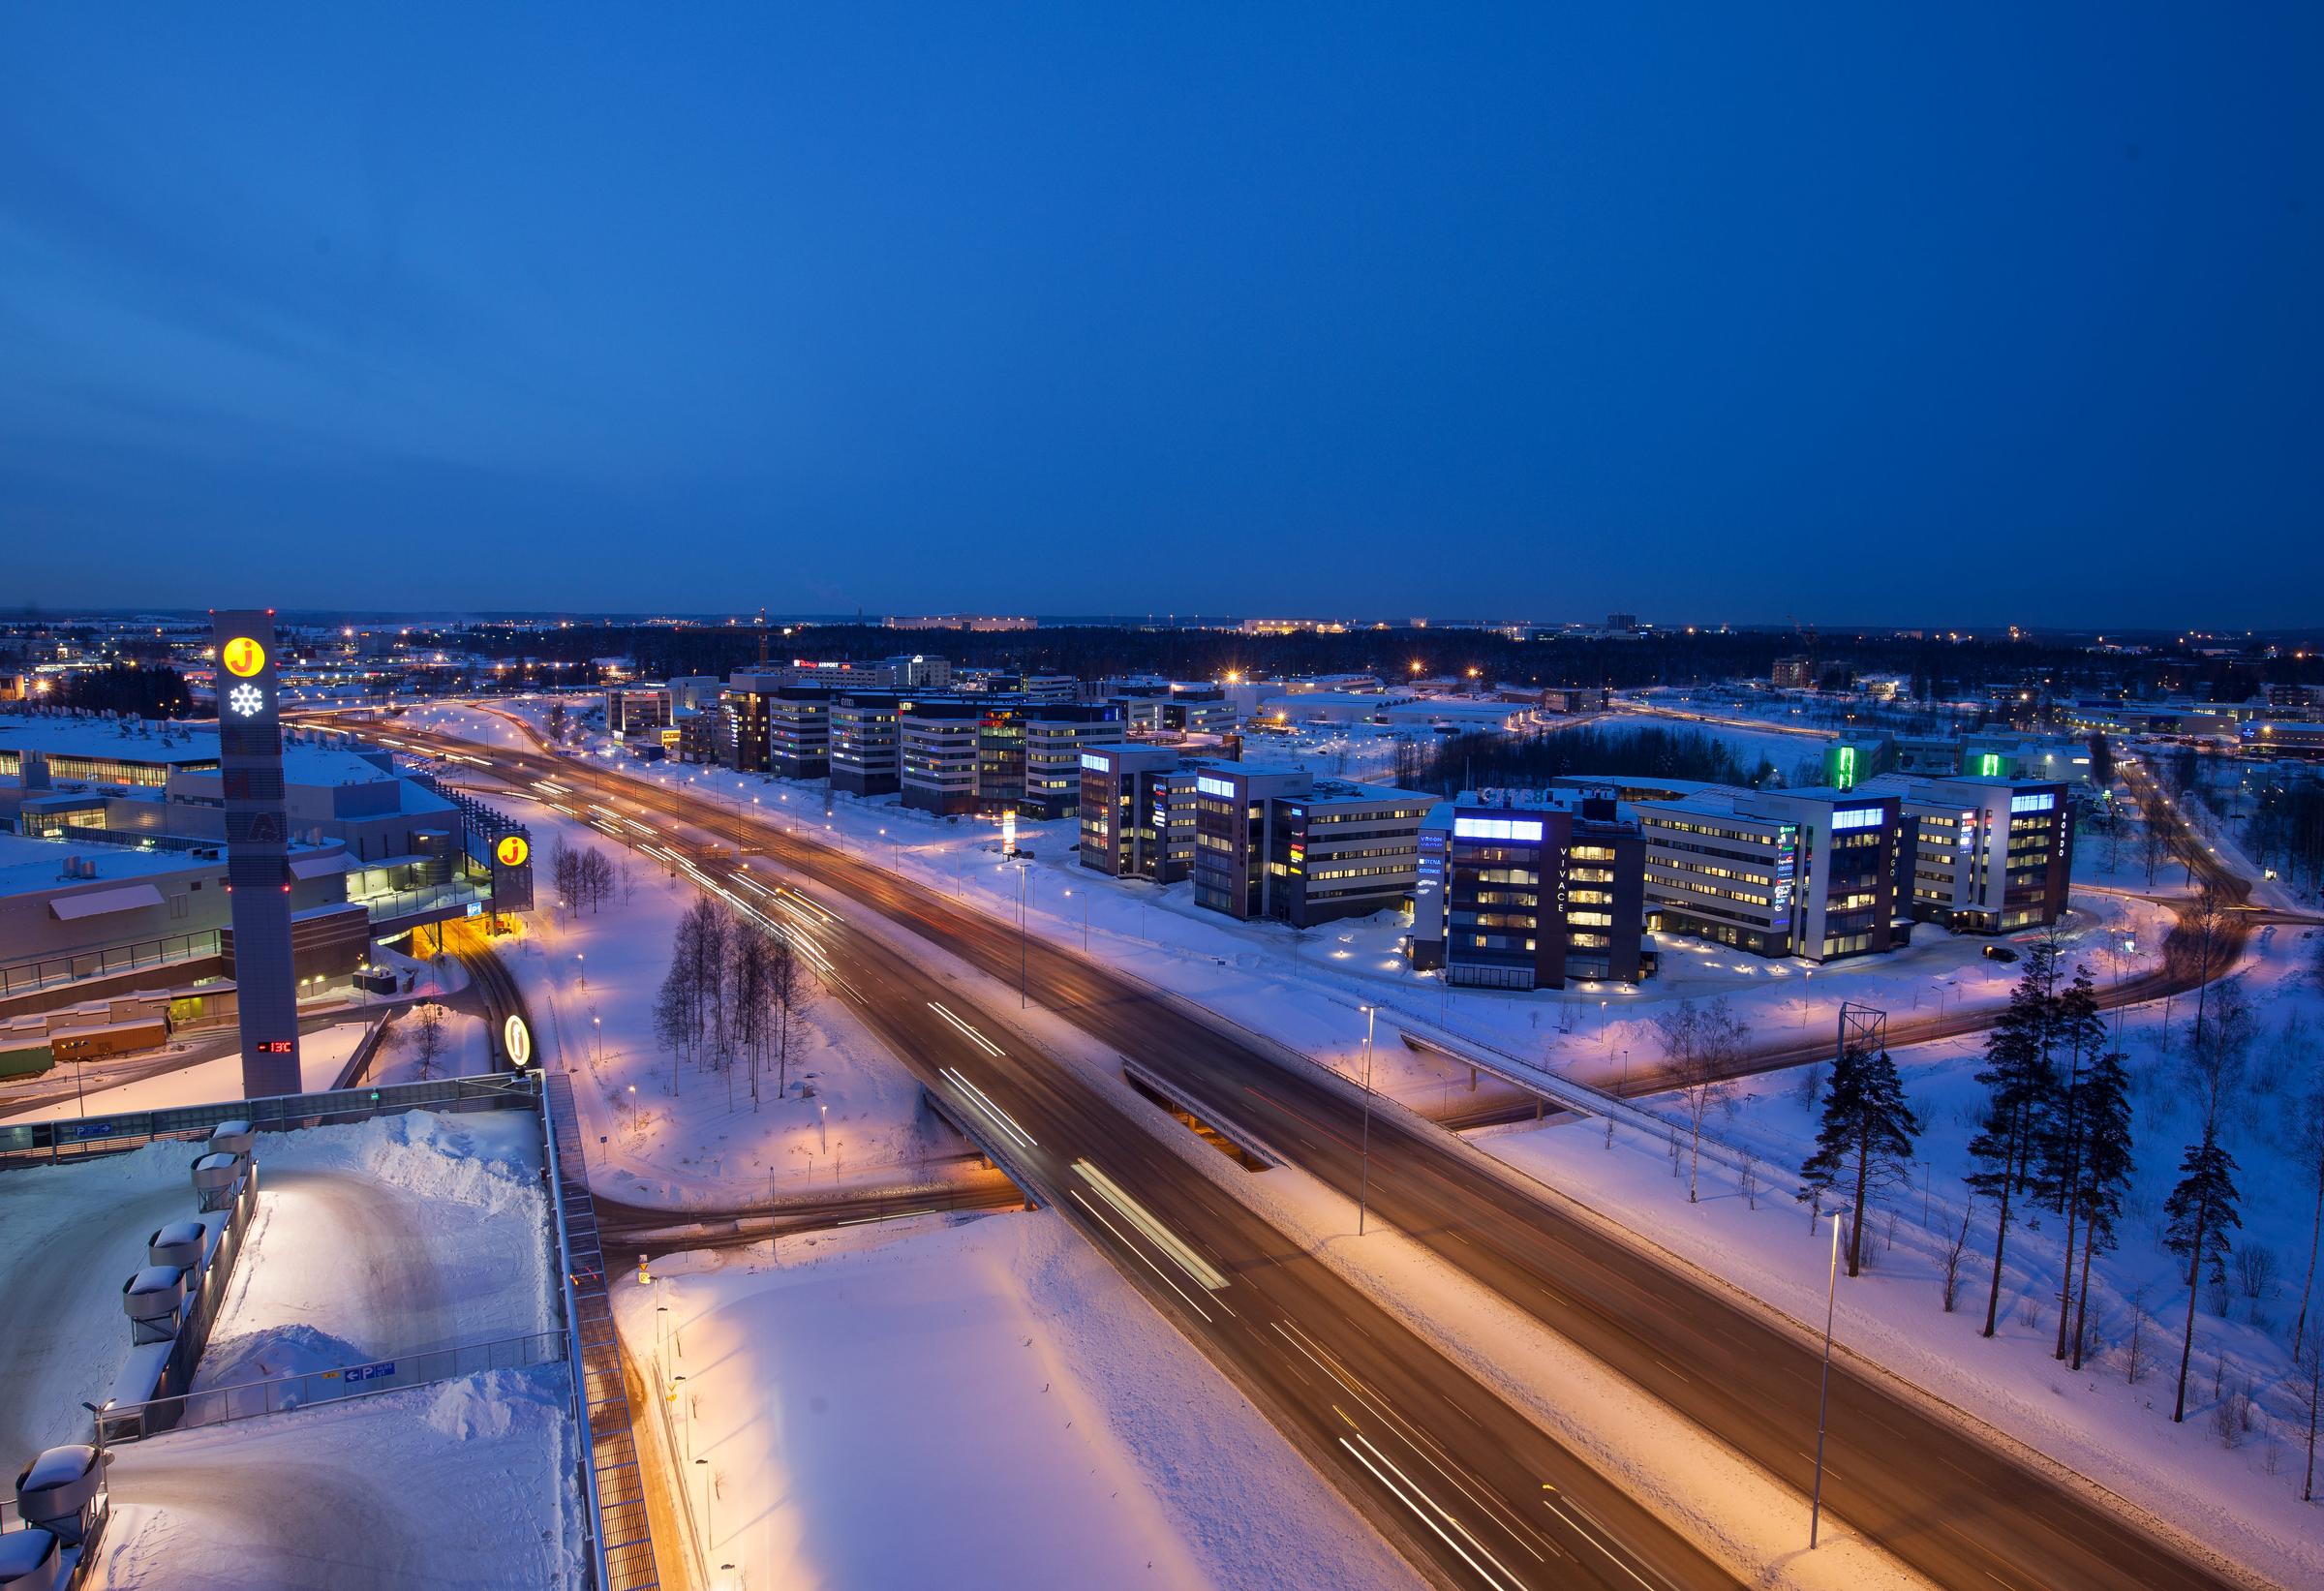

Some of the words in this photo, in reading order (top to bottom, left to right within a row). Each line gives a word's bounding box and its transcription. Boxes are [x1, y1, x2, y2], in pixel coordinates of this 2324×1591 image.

[2059, 811, 2067, 857] RONDO
[1558, 847, 1567, 912] VIVACE
[362, 1367, 373, 1380] P
